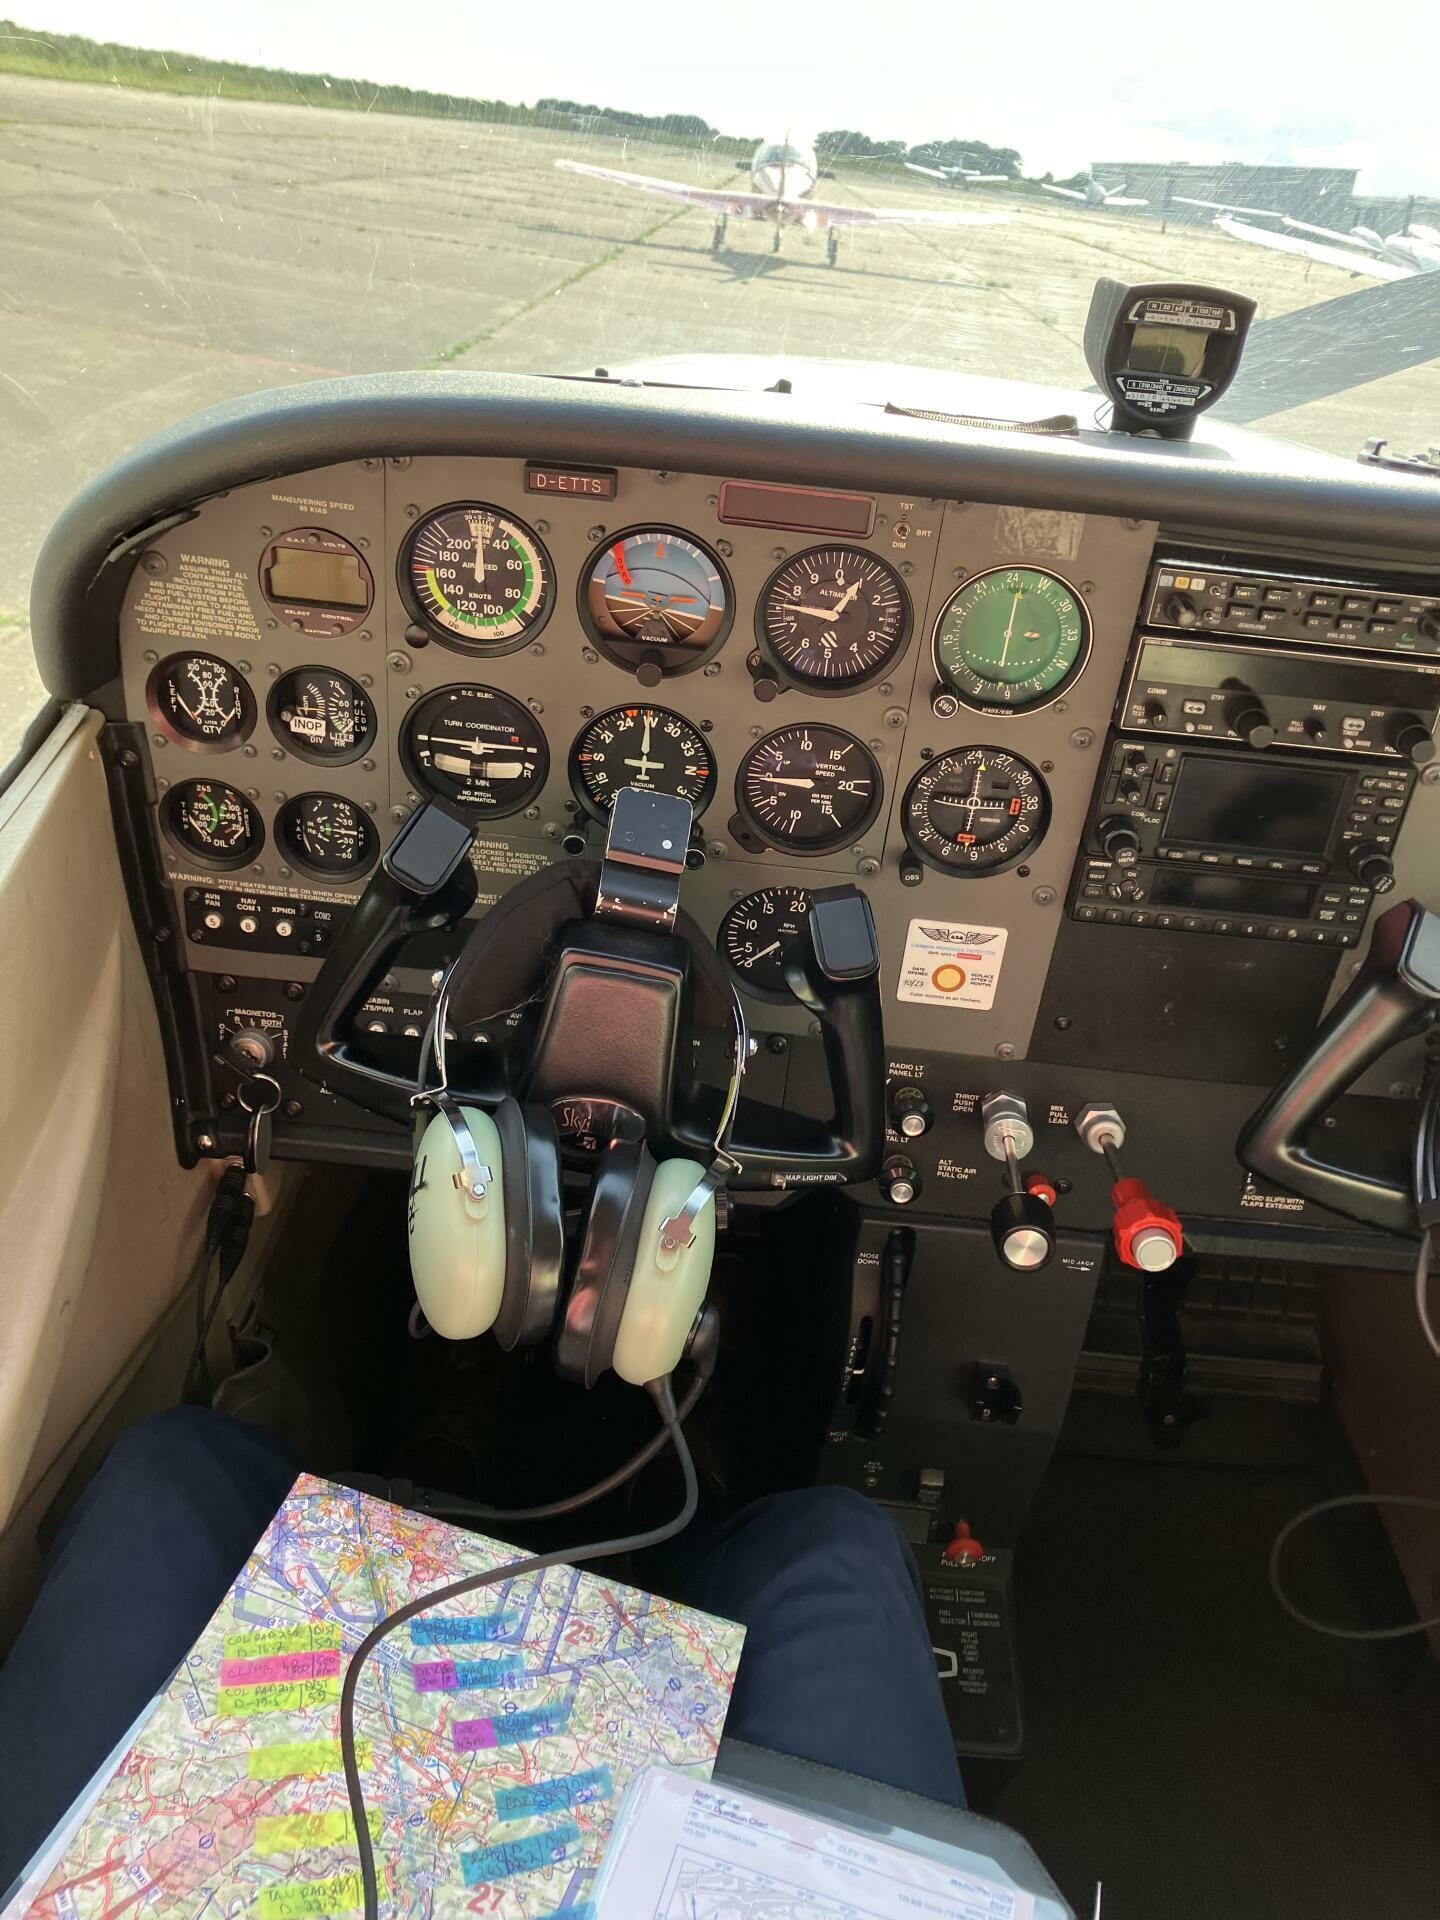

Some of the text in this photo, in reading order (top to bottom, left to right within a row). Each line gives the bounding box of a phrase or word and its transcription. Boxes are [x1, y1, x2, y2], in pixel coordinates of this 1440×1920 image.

[536, 473, 602, 494] D-ETTS
[271, 494, 355, 511] MANEUVERING SPEED
[916, 529, 933, 537] BRT
[323, 541, 346, 549] VOLTS
[446, 538, 471, 550] 200
[492, 540, 510, 550] 40
[892, 541, 907, 549] DIM
[180, 553, 230, 568] WARNING
[439, 551, 459, 562] 180
[179, 565, 209, 574] ASSURE
[462, 561, 498, 571] AIREED
[506, 560, 523, 571] 60
[436, 568, 456, 579] 160
[1006, 572, 1019, 582] 24
[173, 577, 215, 588] INCLUDING
[974, 580, 987, 594] 21
[443, 584, 464, 595] 140
[504, 588, 521, 599] 80
[468, 592, 492, 600] KNOTS
[872, 595, 881, 606] 2
[456, 600, 477, 611] 120
[483, 604, 503, 615] 100
[1059, 598, 1073, 613] 30
[284, 609, 311, 617] SELECT
[321, 613, 355, 621] CONTROL
[161, 615, 189, 624] OWNER
[641, 635, 668, 643] VACUUM
[867, 631, 876, 641] 3
[801, 638, 810, 649] 6
[849, 642, 859, 653] 4
[823, 648, 832, 659] 5
[168, 679, 178, 713] LEFT
[233, 686, 242, 720] RIGHT
[938, 700, 953, 713] OBS
[1313, 704, 1327, 712] NAV
[294, 718, 322, 732] INOP
[444, 719, 515, 733] TURN COORDINATOR
[616, 717, 634, 731] 24
[202, 725, 222, 735] QTY
[663, 722, 681, 738] 30
[329, 732, 354, 743] LITER
[600, 730, 615, 745] 21
[681, 740, 695, 757] 33
[800, 740, 813, 751] 10
[829, 750, 841, 760] 15
[967, 750, 983, 760] 24
[995, 753, 1014, 766] 27
[424, 758, 431, 766] L
[815, 763, 847, 772] VERTICAL
[938, 757, 954, 771] 21
[523, 770, 532, 778] R
[595, 772, 609, 785] 15
[815, 770, 835, 778] SPEED
[1018, 770, 1033, 785] 30
[630, 781, 655, 789] VACUUM
[837, 781, 854, 791] 20
[917, 776, 932, 790] 18
[457, 795, 497, 804] INFORMATION
[1026, 795, 1039, 811] 33
[790, 809, 802, 820] 10
[821, 804, 833, 815] 15
[911, 803, 923, 817] 15
[918, 829, 931, 842] 12
[213, 839, 229, 848] OIL
[473, 840, 509, 850] ARNING
[476, 849, 504, 857] LOCKED
[515, 852, 548, 860] POSITION
[168, 872, 333, 898] WARNING: PITOT HEATER MUST WHEN
[204, 893, 220, 901] AVN
[244, 887, 288, 899] INSTRUMENT
[205, 900, 221, 908] FAN
[240, 897, 257, 905] NAV
[789, 901, 807, 912] 20
[236, 904, 256, 912] COM
[763, 902, 775, 915] 15
[314, 911, 332, 921] COM2
[746, 919, 758, 931] 10
[744, 942, 753, 953] 5
[235, 1008, 277, 1018] MAGNETOS
[403, 1008, 423, 1016] FLAP
[261, 1018, 282, 1027] BOTH
[889, 1062, 914, 1070] RADIO
[889, 1069, 913, 1077] PANEL
[954, 1092, 980, 1101] THROT
[952, 1105, 974, 1113] OPEN
[1050, 1110, 1069, 1119] PULL
[1048, 1117, 1069, 1125] LEAN
[936, 1171, 955, 1179] PULL
[937, 1165, 977, 1175] STATIC AIR
[801, 1174, 823, 1182] LIGHT
[1241, 1194, 1305, 1205] AVOID SLIPS WITH
[1240, 1200, 1304, 1211] FLAPS EXTENDED
[857, 1258, 880, 1266] DOWN
[941, 1559, 958, 1567] PULL
[564, 1619, 596, 1645] 25
[466, 1883, 507, 1916] 27
